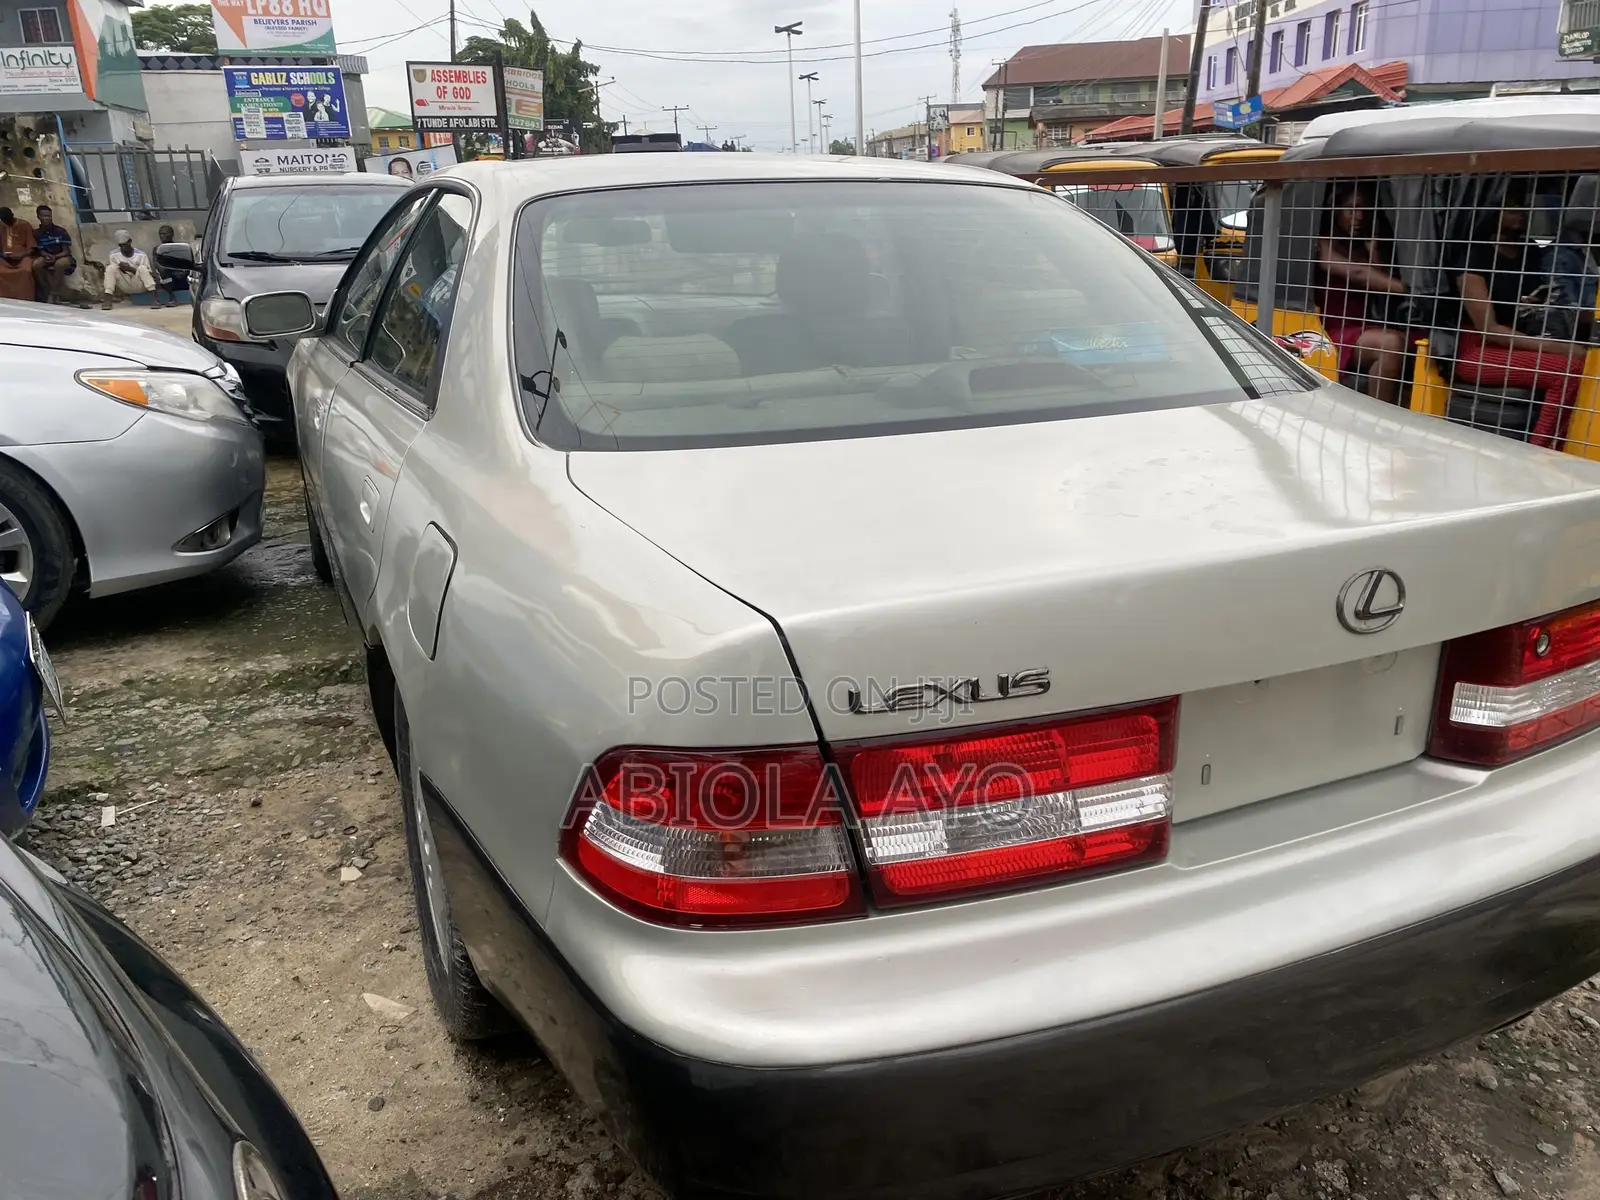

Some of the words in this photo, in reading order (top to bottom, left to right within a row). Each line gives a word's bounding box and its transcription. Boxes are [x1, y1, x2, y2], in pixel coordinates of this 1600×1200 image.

[253, 18, 289, 26] BELIEVERS
[250, 72, 288, 85] GABLIZ
[290, 72, 335, 85] SCHOOLS
[430, 69, 487, 84] ASSEMBLIES
[436, 86, 448, 99] OF
[452, 87, 471, 100] GOD
[423, 119, 447, 128] TUNDE
[449, 119, 480, 128] AFOLABI
[481, 119, 499, 128] STR.
[847, 667, 1051, 714] LEXUS
